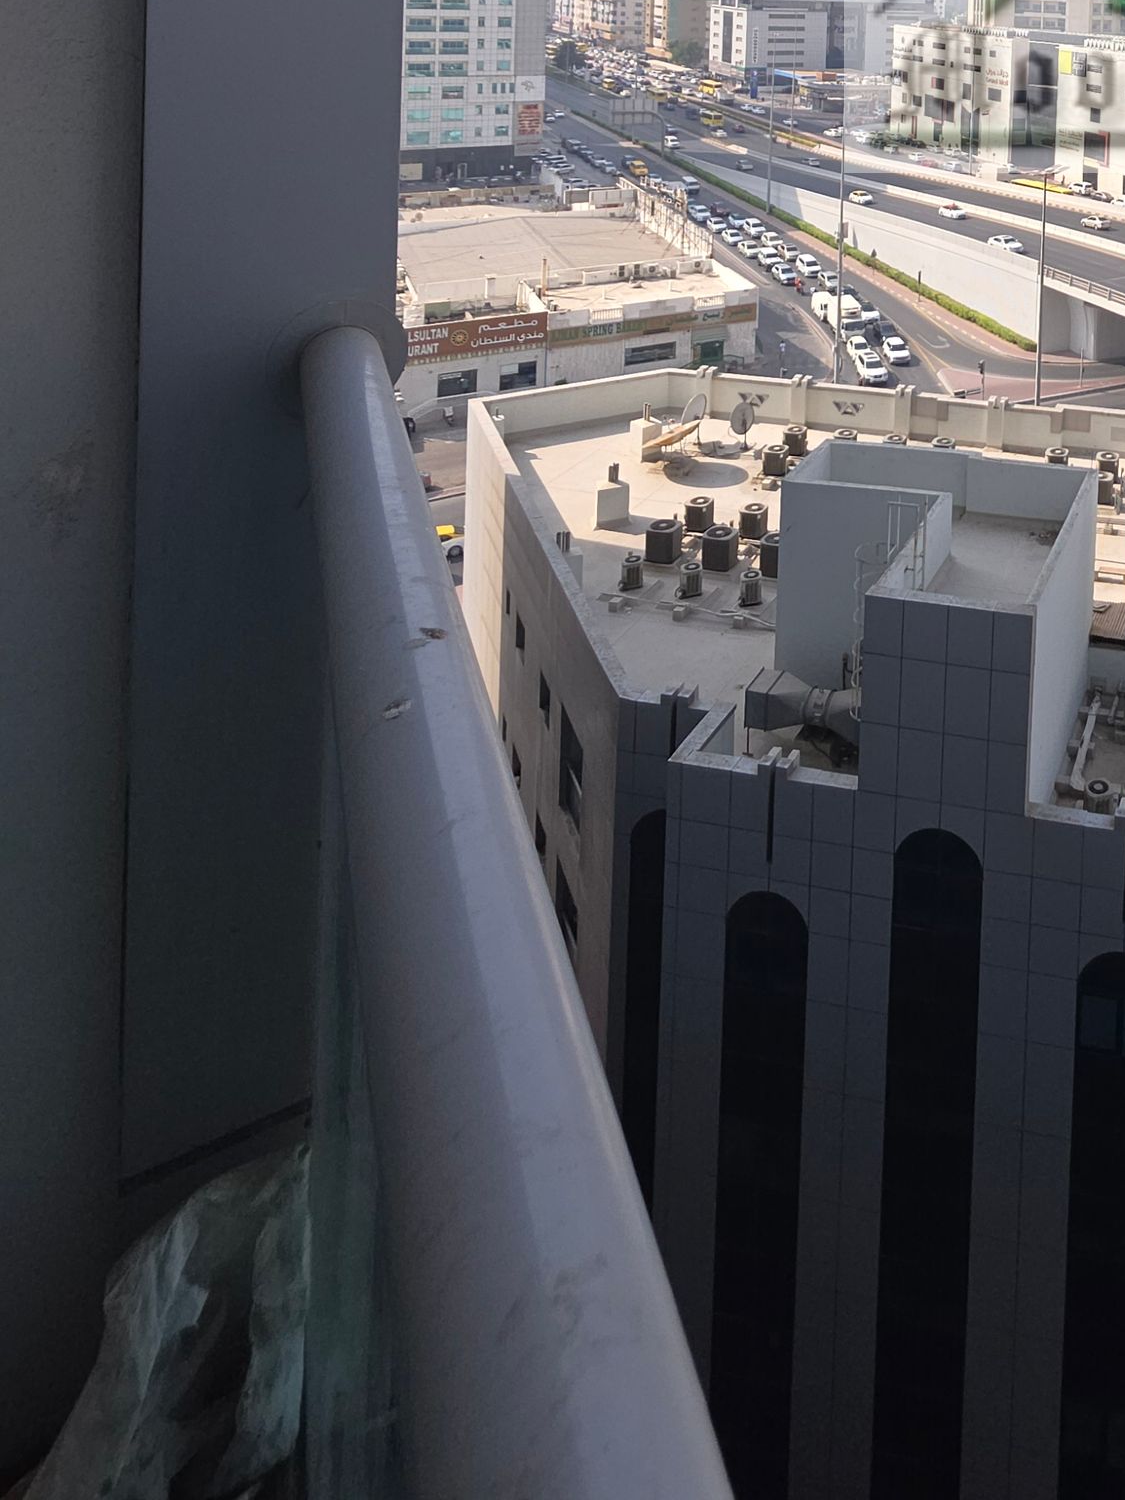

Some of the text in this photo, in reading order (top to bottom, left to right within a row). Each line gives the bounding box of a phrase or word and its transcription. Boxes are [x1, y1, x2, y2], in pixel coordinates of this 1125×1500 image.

[478, 318, 539, 334] مطعم
[581, 322, 614, 338] SPRING
[407, 327, 449, 343] LSULTAN
[470, 331, 545, 348] مندي السلطان
[407, 343, 440, 357] URANT
